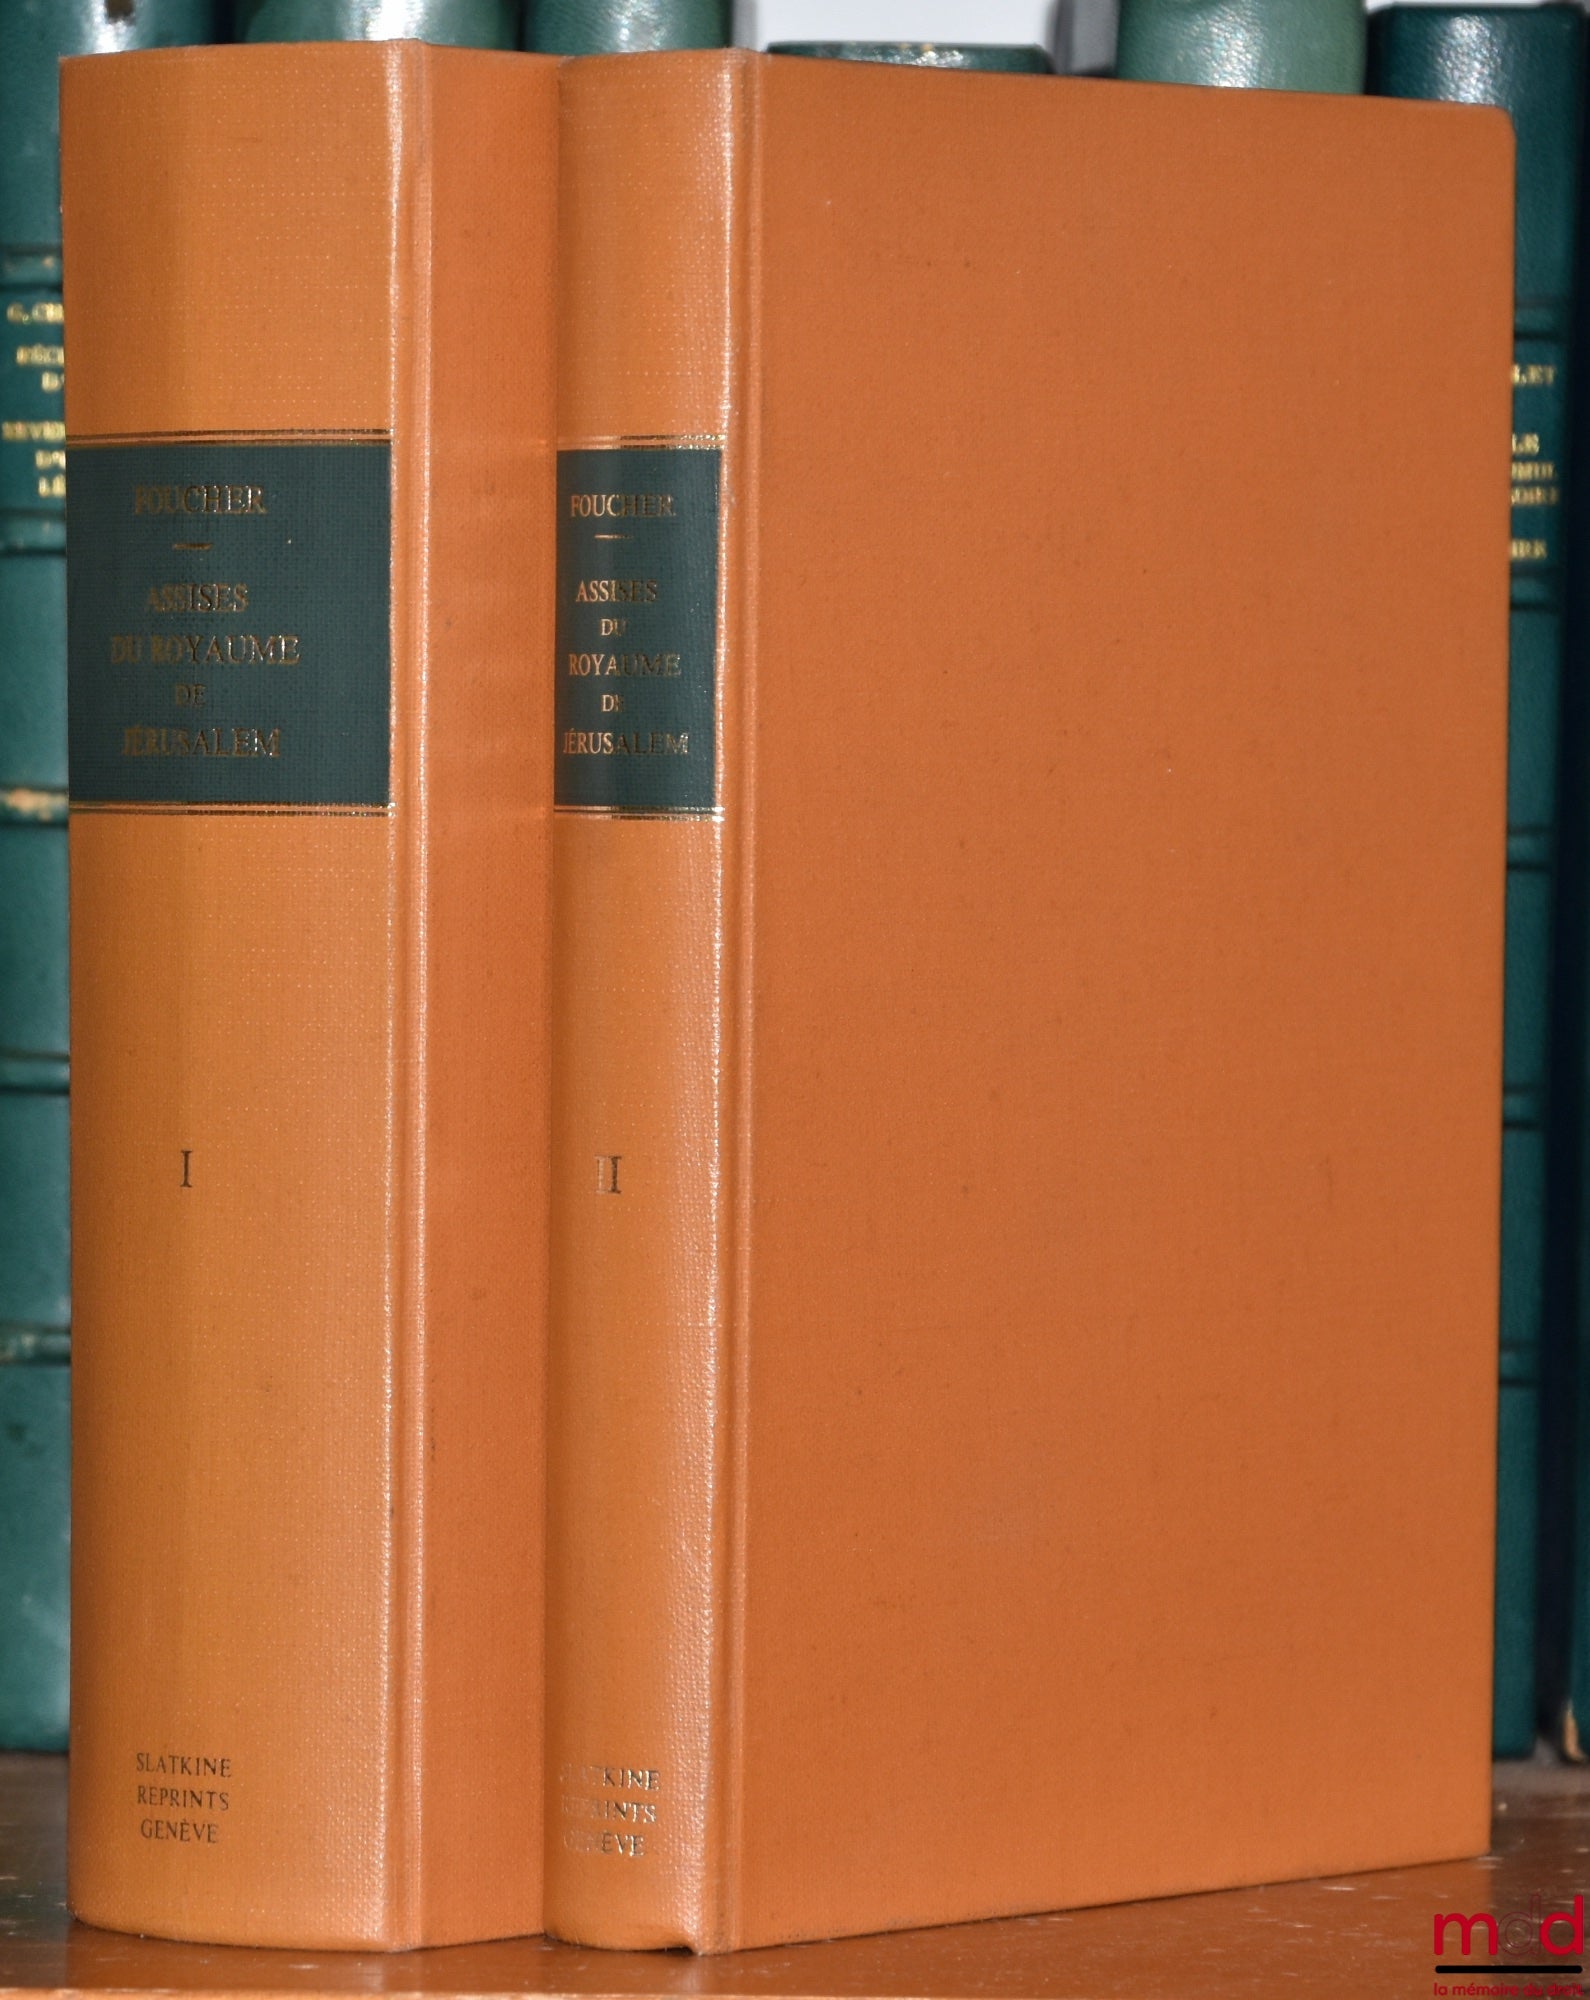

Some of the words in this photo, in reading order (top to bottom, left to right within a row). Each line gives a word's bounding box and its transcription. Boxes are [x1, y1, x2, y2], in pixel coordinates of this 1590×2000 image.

[132, 484, 267, 515] FOUCHER
[569, 493, 676, 517] FOUCHER
[146, 582, 250, 613] ASSISES
[575, 579, 658, 603] ASSISES
[600, 617, 627, 637] DU
[110, 635, 143, 665] DU
[151, 635, 302, 666] ROYAUME
[568, 652, 682, 677] ROYAUME
[174, 682, 207, 707] DE
[121, 722, 282, 758] JÉRUSALEM
[563, 726, 690, 756] JÉRUSALEM
[180, 1149, 193, 1188] I
[594, 1154, 622, 1195] II
[135, 1752, 232, 1778] SLATKINE
[136, 1784, 230, 1812] REPRINTS
[140, 1817, 220, 1844] GENÈVE
